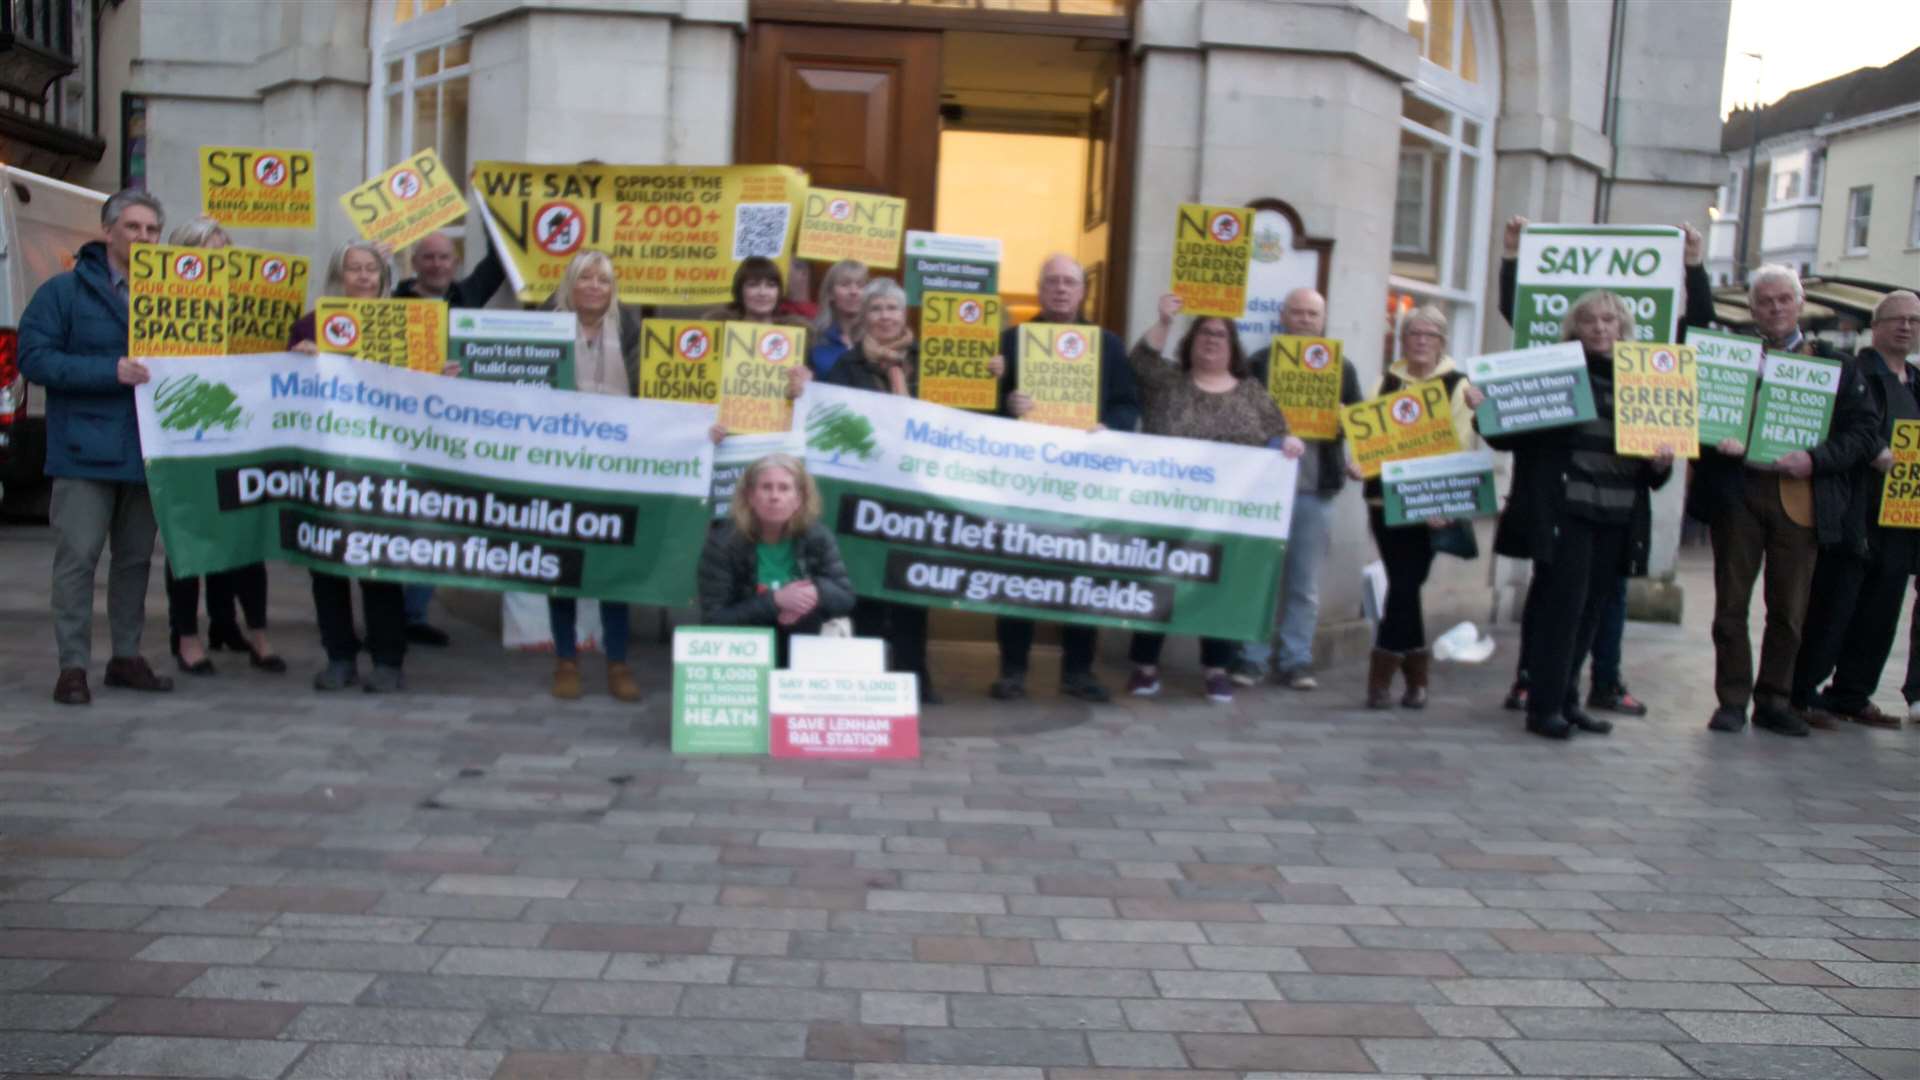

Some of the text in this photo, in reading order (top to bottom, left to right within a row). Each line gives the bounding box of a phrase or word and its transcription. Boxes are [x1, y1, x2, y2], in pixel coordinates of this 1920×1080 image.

[208, 151, 309, 188] STOP
[350, 156, 435, 224] STOP
[483, 172, 533, 197] WE
[543, 173, 604, 198] SAY
[613, 175, 723, 190] OPPOSE THE
[615, 189, 721, 203] BUILDING OF
[289, 203, 310, 212] ON
[616, 204, 721, 229] 2,000+
[613, 230, 720, 244] NEW HOMES
[867, 226, 897, 240] OUR
[612, 245, 719, 260] IN LIDSING
[1176, 242, 1247, 259] LIDSING
[133, 249, 225, 283] STOP
[1175, 256, 1246, 272] GARDEN
[1537, 246, 1662, 277] SAY NO
[674, 264, 727, 281] NOW!
[1174, 269, 1246, 287] VILLAGE
[134, 282, 164, 293] OUR
[133, 295, 224, 320] GREEN
[925, 296, 998, 325] STOP
[1531, 293, 1569, 316] TO
[133, 319, 224, 344] SPACES
[465, 342, 561, 360] Don't let them
[925, 337, 996, 358] GREEN
[1696, 341, 1752, 363] SAY NO
[472, 361, 550, 376] build on our
[655, 361, 708, 380] GIVE
[1024, 362, 1094, 377] LIDSING
[1617, 345, 1695, 375] STOP
[1023, 375, 1094, 390] GARDEN
[1273, 370, 1337, 385] LIDSING
[1486, 373, 1575, 397] Don't let them
[1773, 363, 1832, 387] SAY NO
[643, 379, 717, 400] LIDSING
[723, 378, 789, 400] LIDSIN
[1272, 383, 1337, 396] GARDEN
[1618, 386, 1694, 407] GREEN
[1769, 386, 1787, 399] TO
[271, 371, 629, 443] Maidstone Conservatives
[1496, 391, 1569, 411] build on our
[1348, 386, 1443, 441] STOP
[1500, 405, 1575, 428] green fields
[1618, 406, 1695, 428] SPACES
[1699, 405, 1744, 426] EATH
[1776, 413, 1823, 431] LENHAM
[271, 409, 703, 479] are destroying our environment
[1431, 428, 1453, 441] ON
[1760, 424, 1819, 447] HEATH
[904, 418, 1217, 485] Maidstone Conservatives
[898, 453, 1283, 523] are destroying our environment
[1396, 476, 1481, 495] Don't let them
[238, 466, 623, 540] Don't let them build on
[1404, 490, 1472, 505] build on our
[1405, 500, 1476, 520] green fields
[854, 498, 1211, 577] Don't let them build on
[297, 521, 561, 580] our green fields
[906, 562, 1155, 614] our green fields
[687, 640, 758, 657] SAY NO
[685, 667, 707, 680] TO
[683, 707, 759, 727] HEATH
[787, 717, 891, 732] SAVE LENHAM
[789, 732, 890, 747] RAIL STATION
